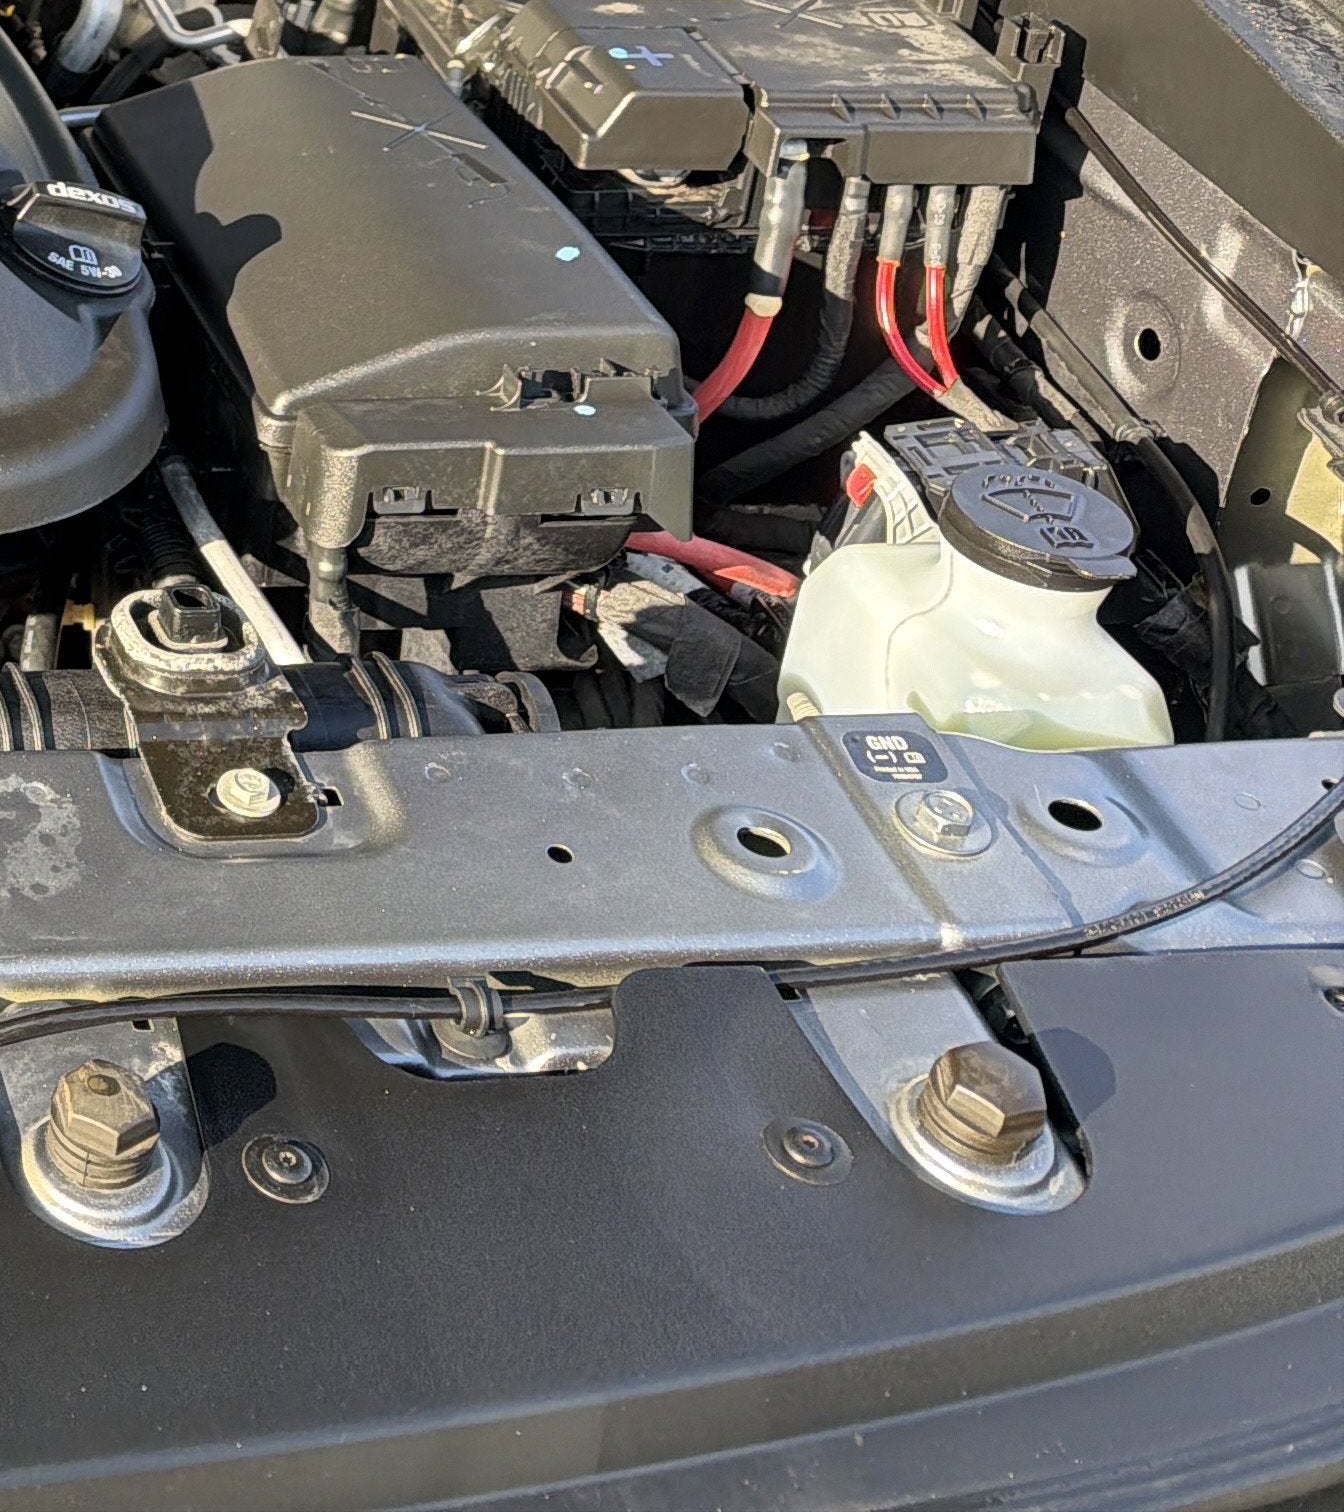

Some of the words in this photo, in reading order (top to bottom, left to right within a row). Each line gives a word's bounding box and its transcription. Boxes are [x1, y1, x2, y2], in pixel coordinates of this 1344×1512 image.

[46, 181, 138, 214] dexos
[47, 251, 75, 271] SAE
[865, 735, 909, 750] GND
